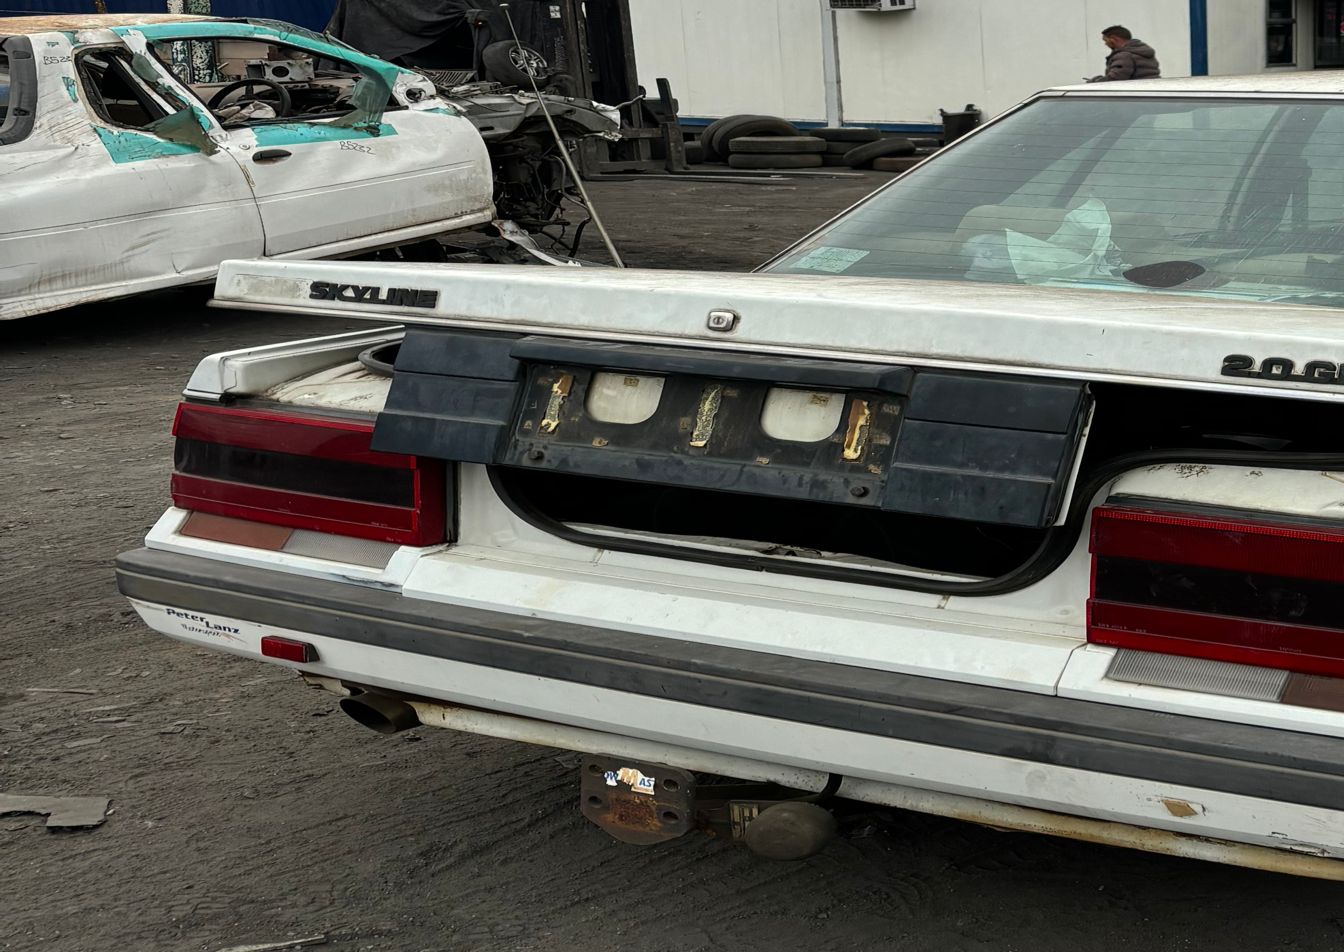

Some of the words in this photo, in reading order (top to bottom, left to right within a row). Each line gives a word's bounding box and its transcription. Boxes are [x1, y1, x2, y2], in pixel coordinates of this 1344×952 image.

[308, 280, 438, 309] SKYLINE
[165, 608, 207, 622] Peter
[205, 621, 241, 635] Lanz
